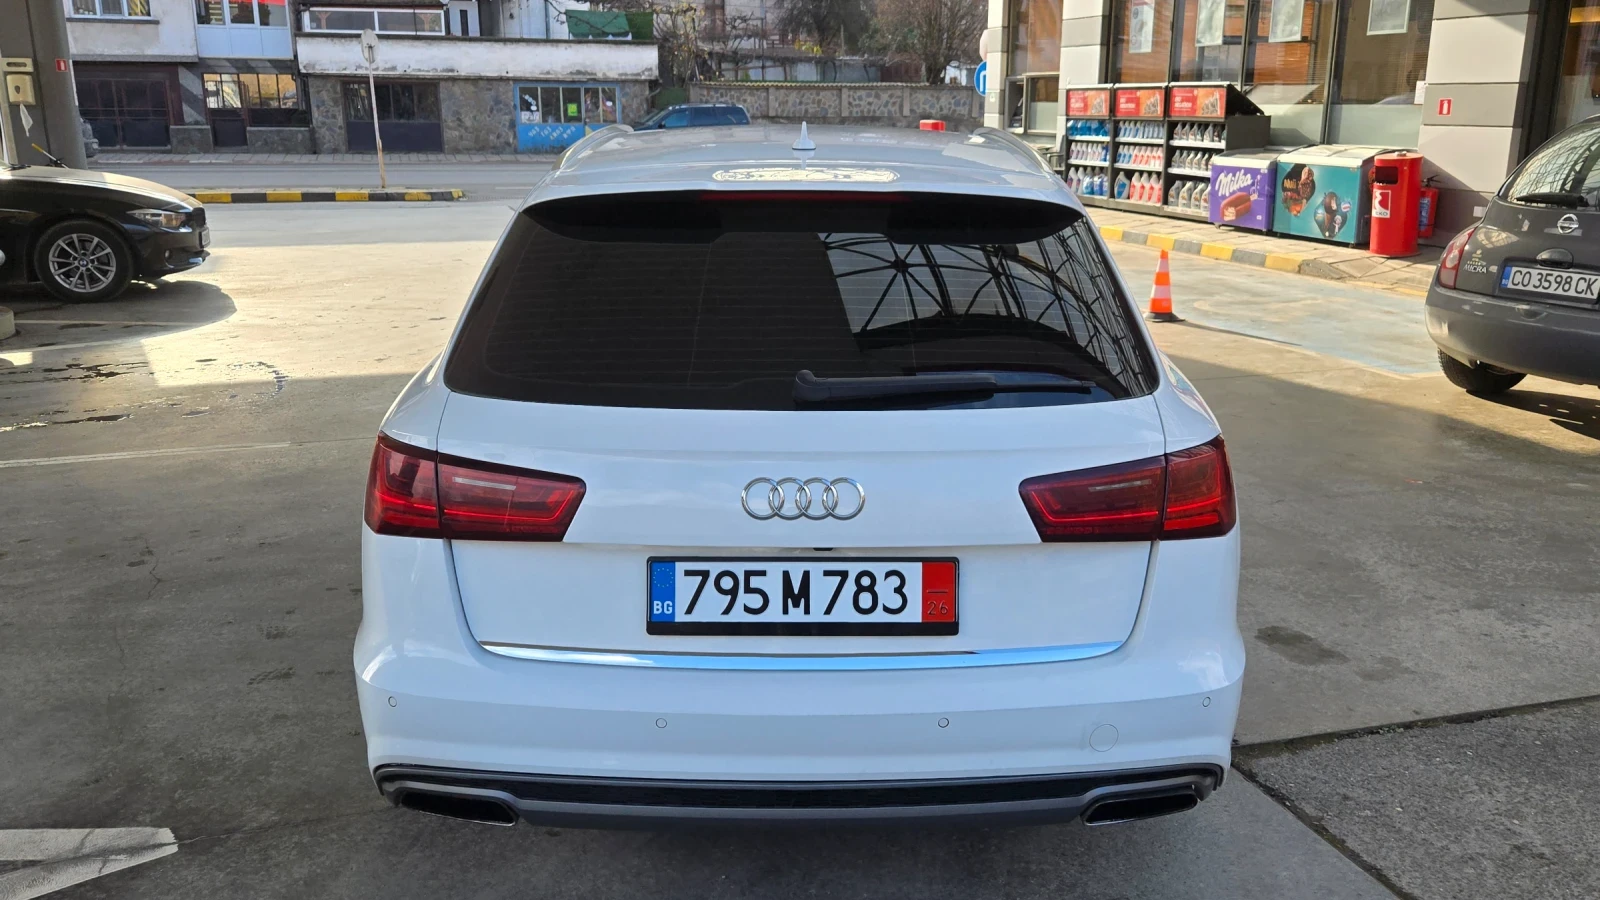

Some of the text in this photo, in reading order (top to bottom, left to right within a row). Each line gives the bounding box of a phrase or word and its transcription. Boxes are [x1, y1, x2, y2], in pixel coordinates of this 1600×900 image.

[1215, 169, 1253, 197] Milka
[1463, 264, 1487, 274] MICRA
[1511, 270, 1598, 296] CO 3598 CK
[683, 569, 909, 616] 795 M 783
[653, 601, 673, 614] BG
[927, 601, 948, 615] 26
